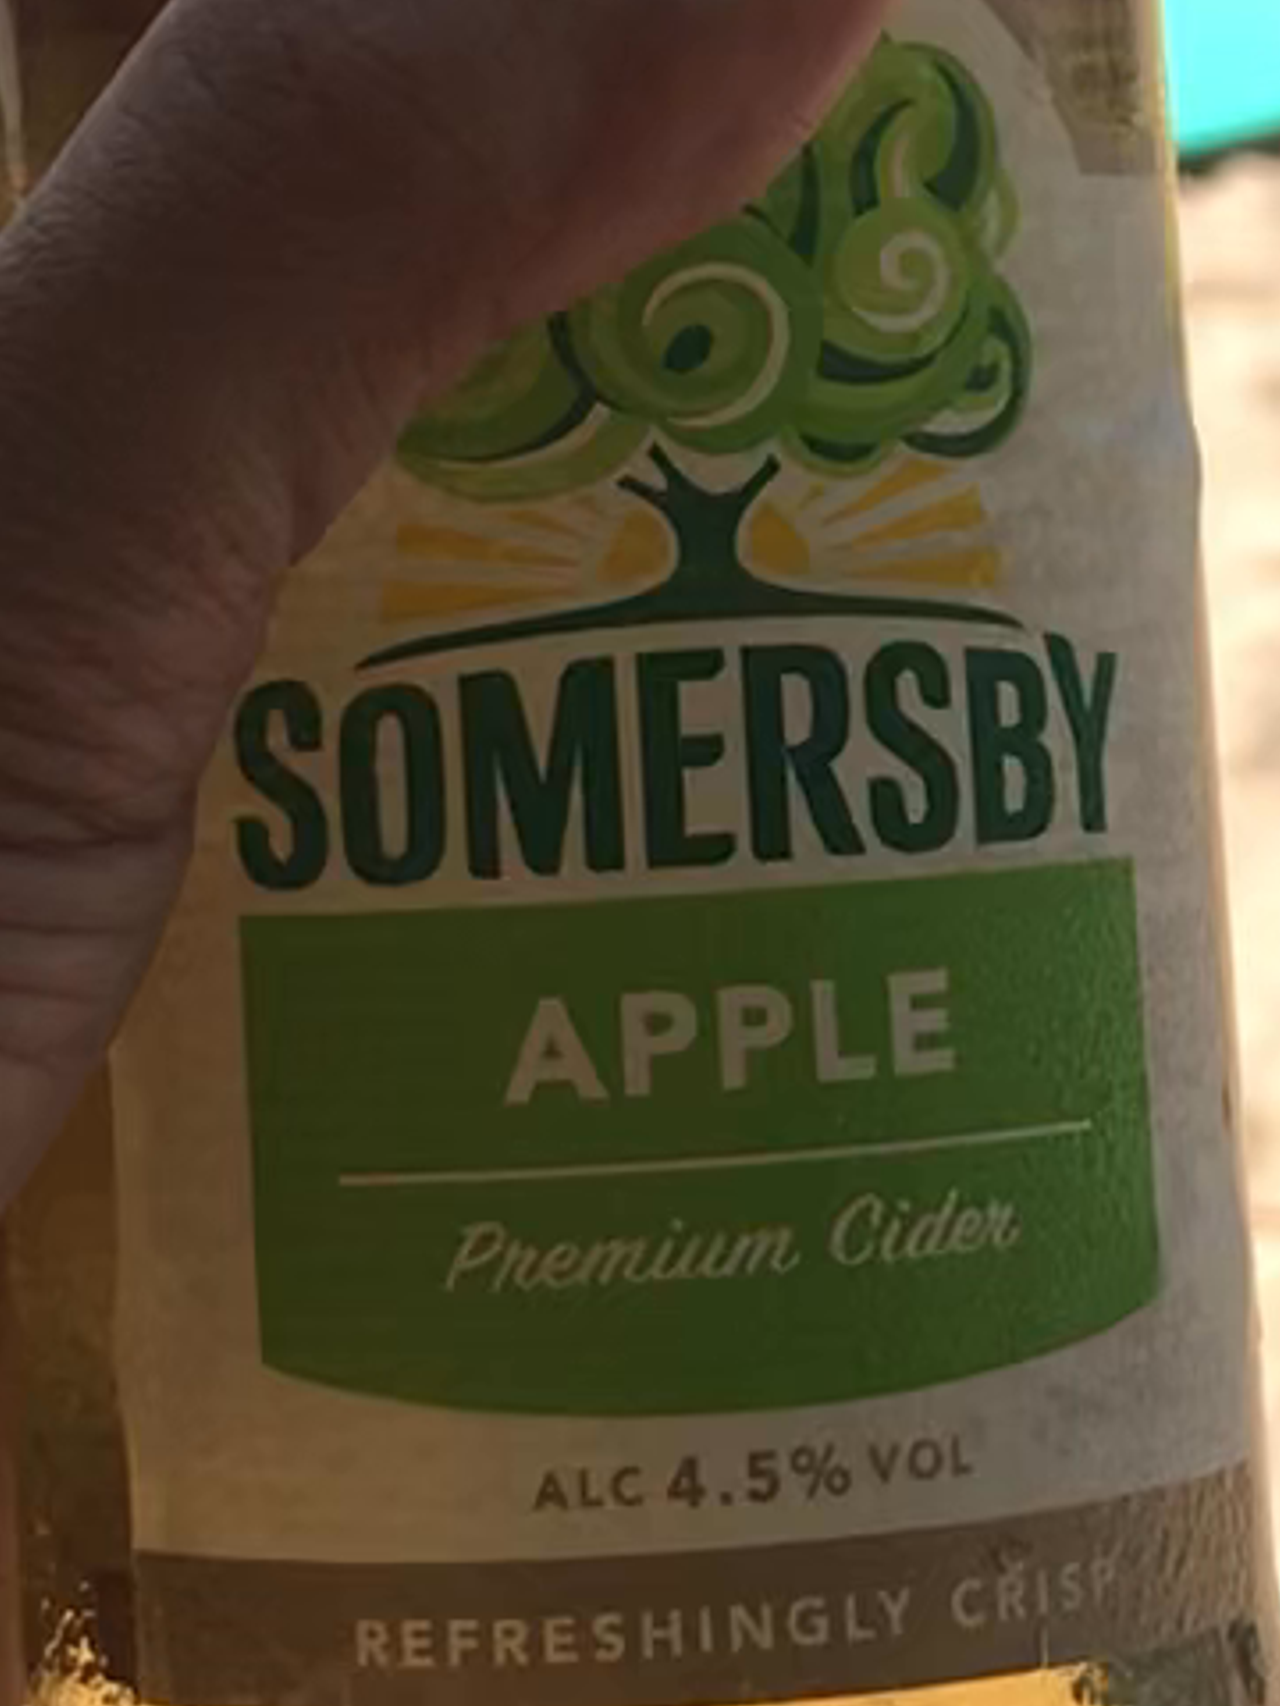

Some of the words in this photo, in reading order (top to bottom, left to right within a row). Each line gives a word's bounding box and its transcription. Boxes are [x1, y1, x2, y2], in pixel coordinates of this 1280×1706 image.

[231, 629, 1117, 892] SOMERSBY
[503, 967, 958, 1107] APPLE
[443, 1216, 800, 1294] Premium
[827, 1189, 1023, 1268] Cider
[532, 1466, 645, 1514] ALC
[665, 1442, 853, 1510] 4.5%
[867, 1434, 975, 1486] VOL
[353, 1586, 914, 1668] REFRESHINGLY
[950, 1556, 1118, 1628] CRISP
